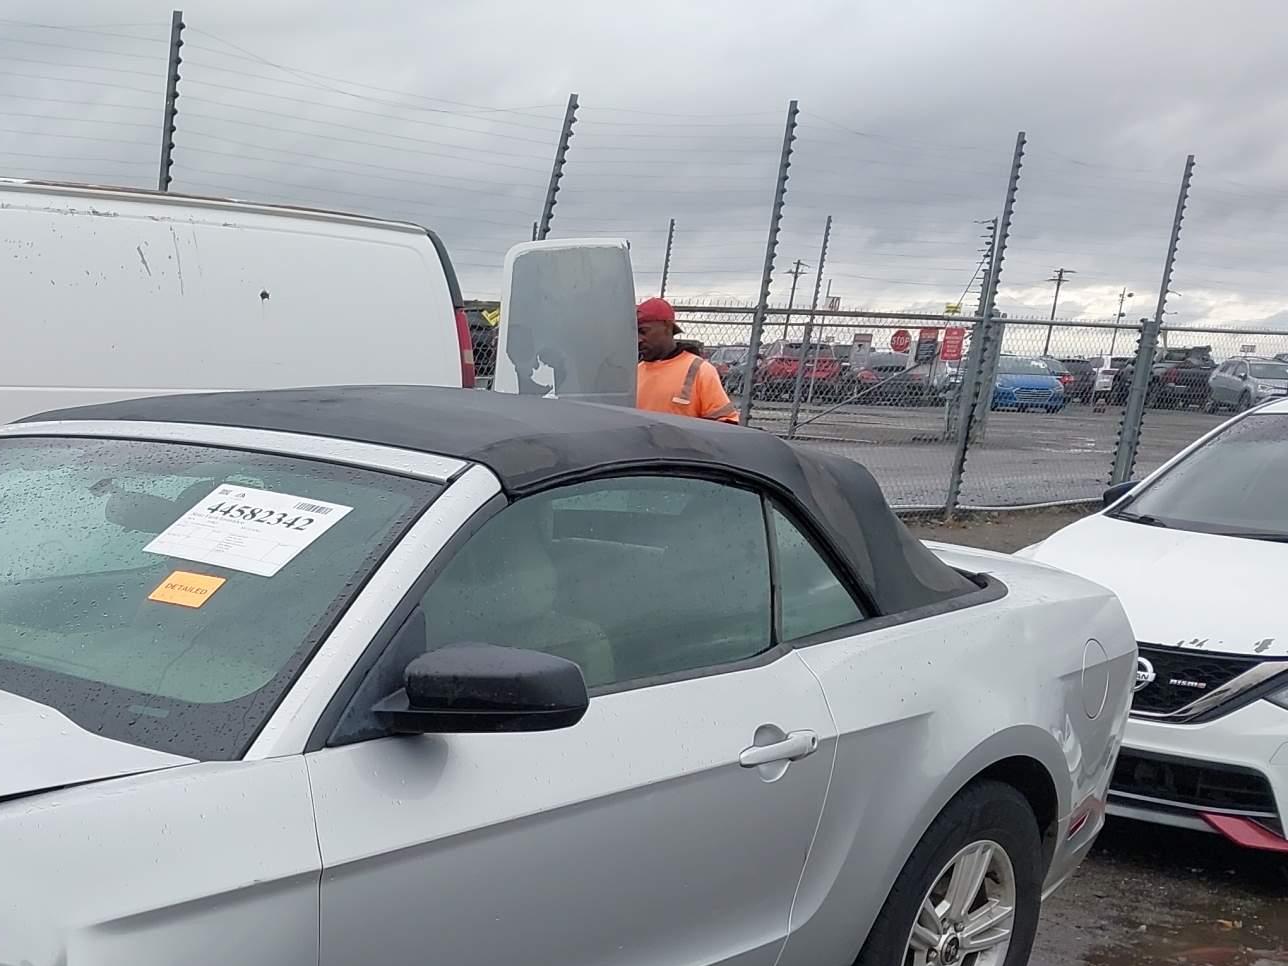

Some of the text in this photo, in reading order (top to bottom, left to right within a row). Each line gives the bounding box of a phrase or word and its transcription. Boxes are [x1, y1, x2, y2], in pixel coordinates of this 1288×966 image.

[891, 335, 910, 345] STOP
[207, 501, 315, 531] 44582342
[164, 582, 208, 596] DETAILED
